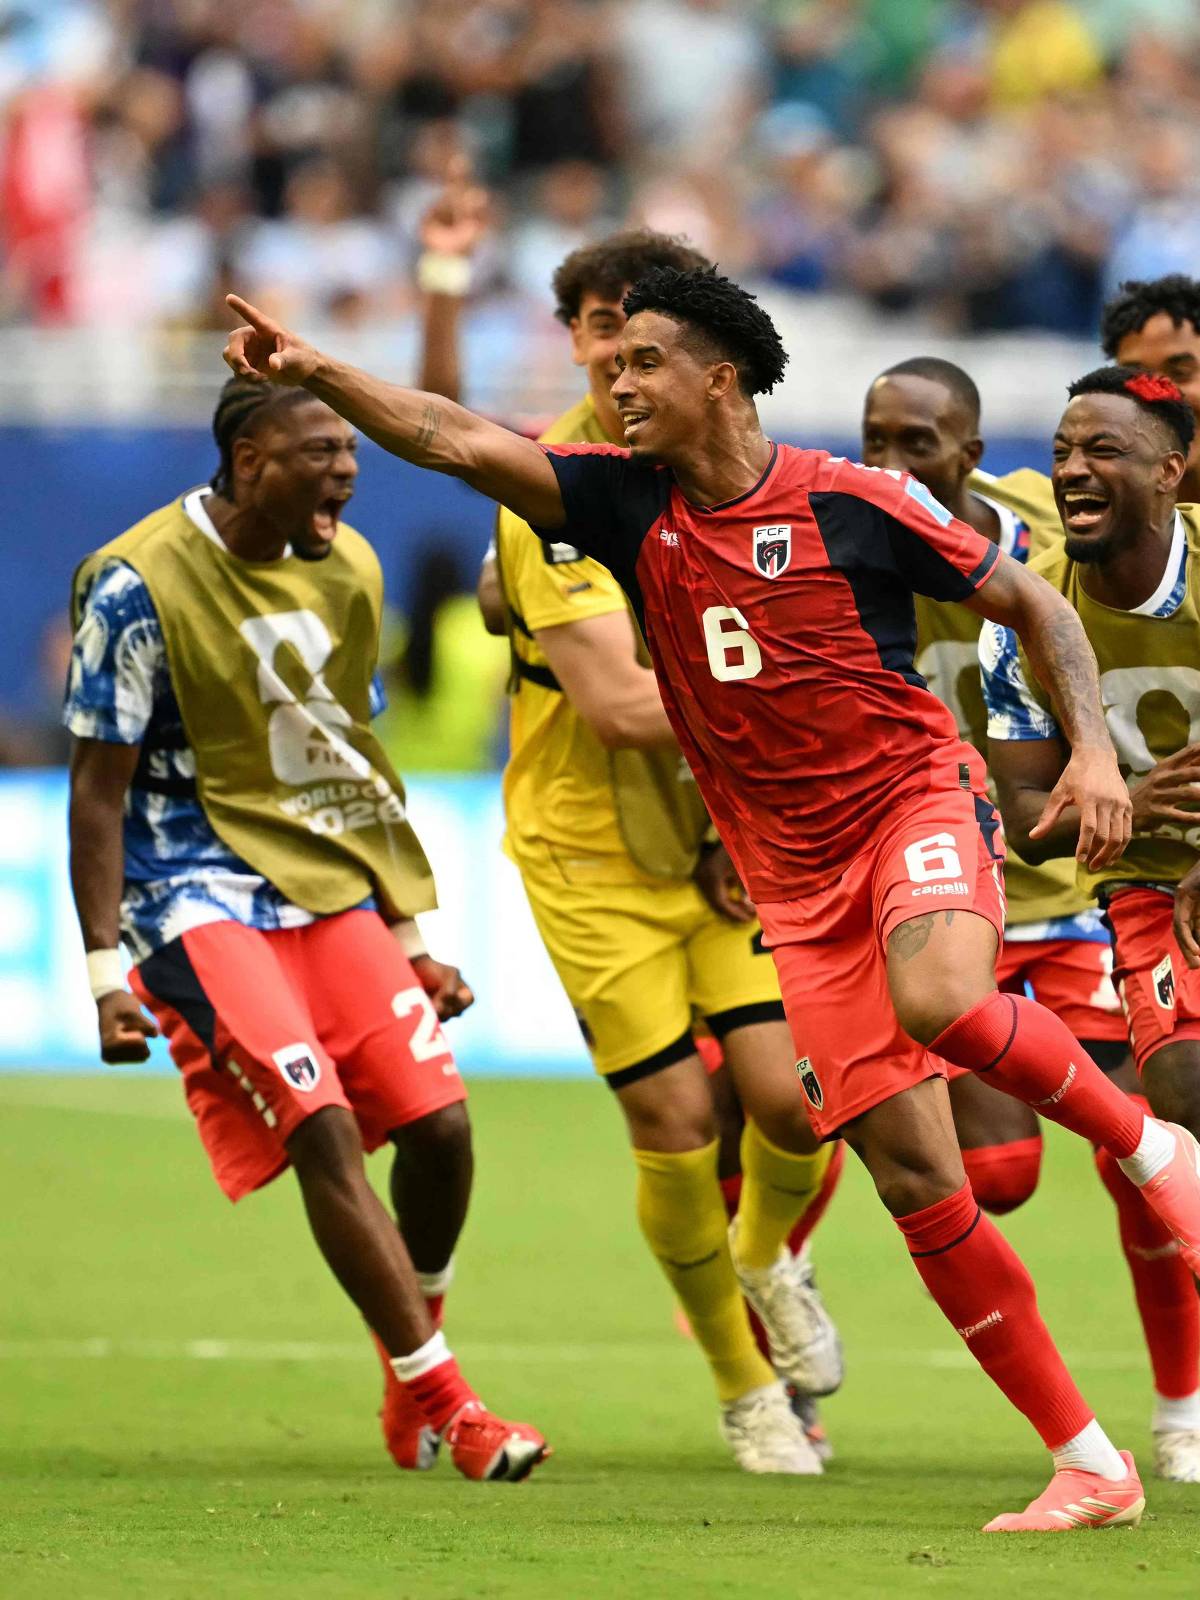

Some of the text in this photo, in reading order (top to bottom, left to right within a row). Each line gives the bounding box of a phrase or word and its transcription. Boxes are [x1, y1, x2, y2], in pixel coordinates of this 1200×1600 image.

[756, 527, 788, 538] FCF
[702, 606, 762, 682] 6
[904, 832, 963, 883] 6
[912, 881, 969, 896] capelli
